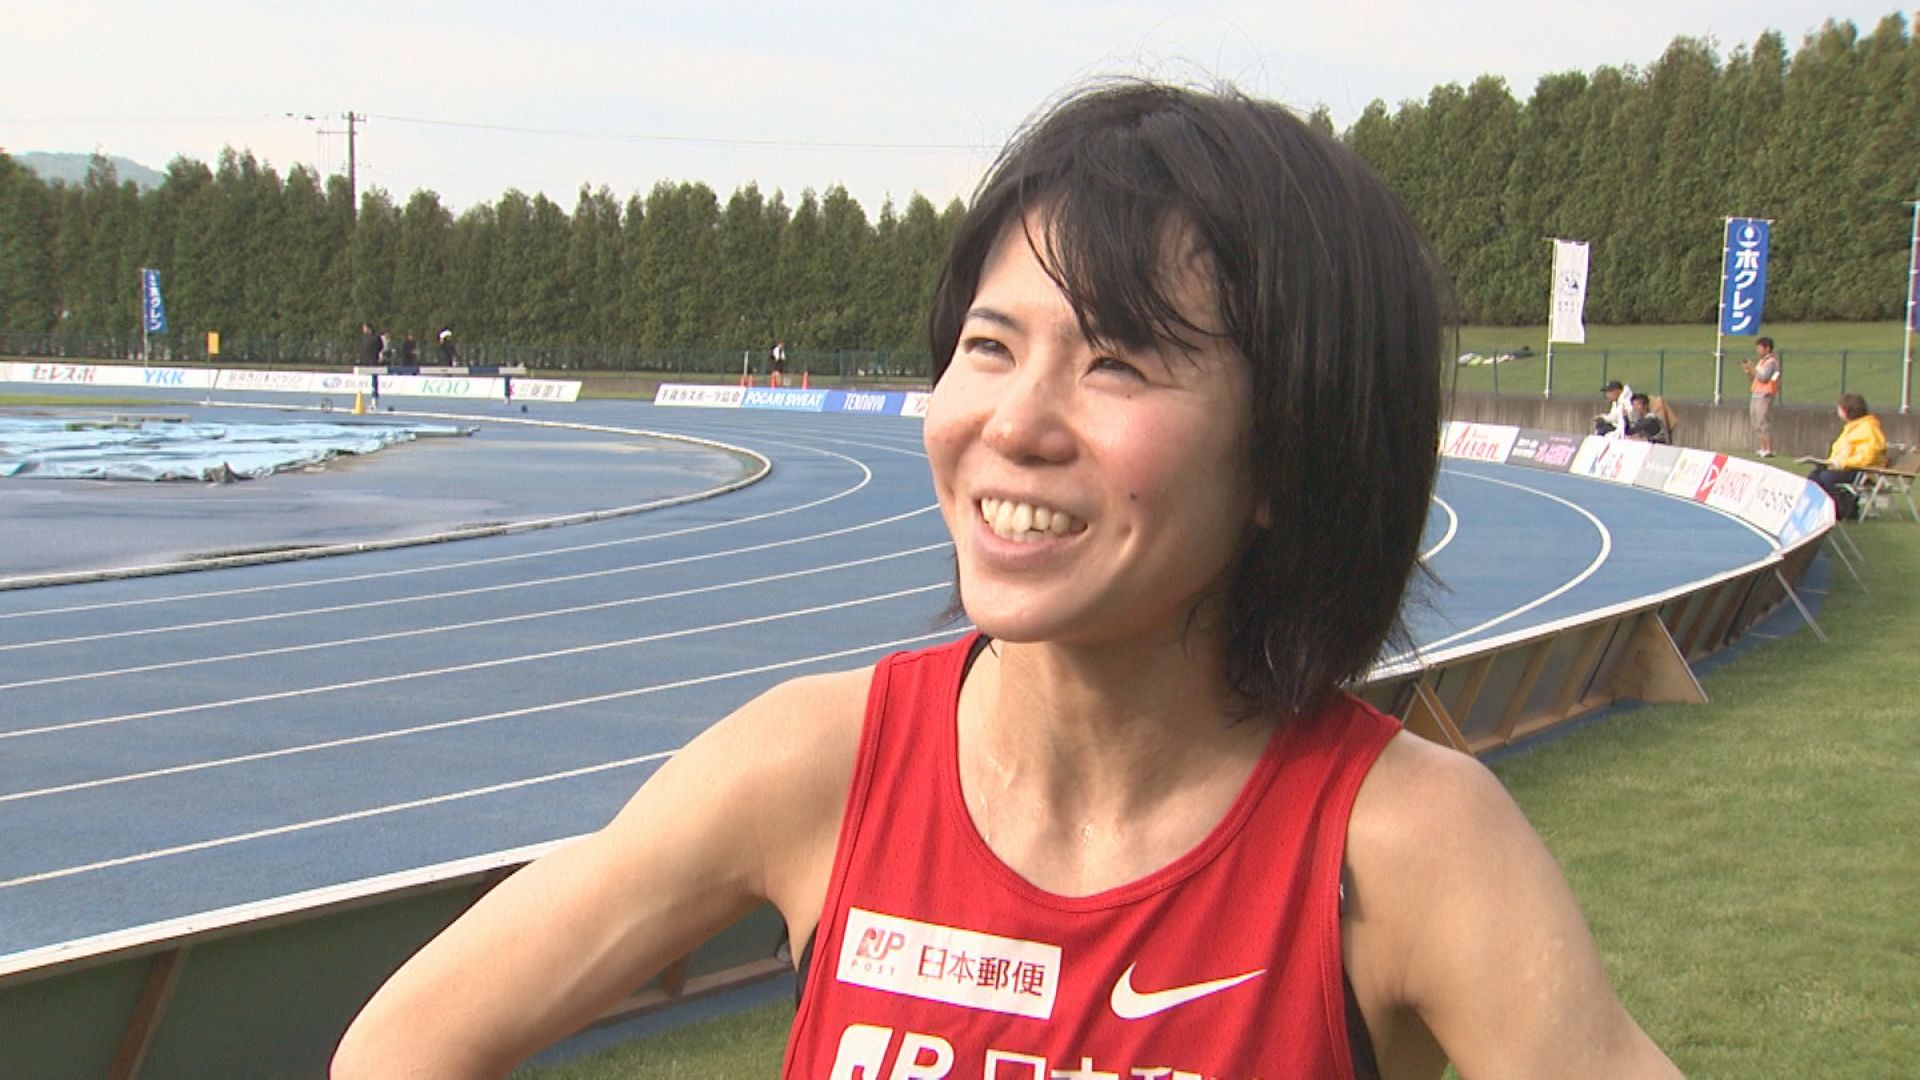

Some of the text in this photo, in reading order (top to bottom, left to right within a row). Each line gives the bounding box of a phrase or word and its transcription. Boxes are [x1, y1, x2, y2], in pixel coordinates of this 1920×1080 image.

[1731, 248, 1761, 332] ホクレン
[143, 368, 186, 385] YKK
[745, 390, 823, 408] POCARI SWEAT
[851, 959, 897, 977] POST
[917, 944, 1047, 997] 日本郵便
